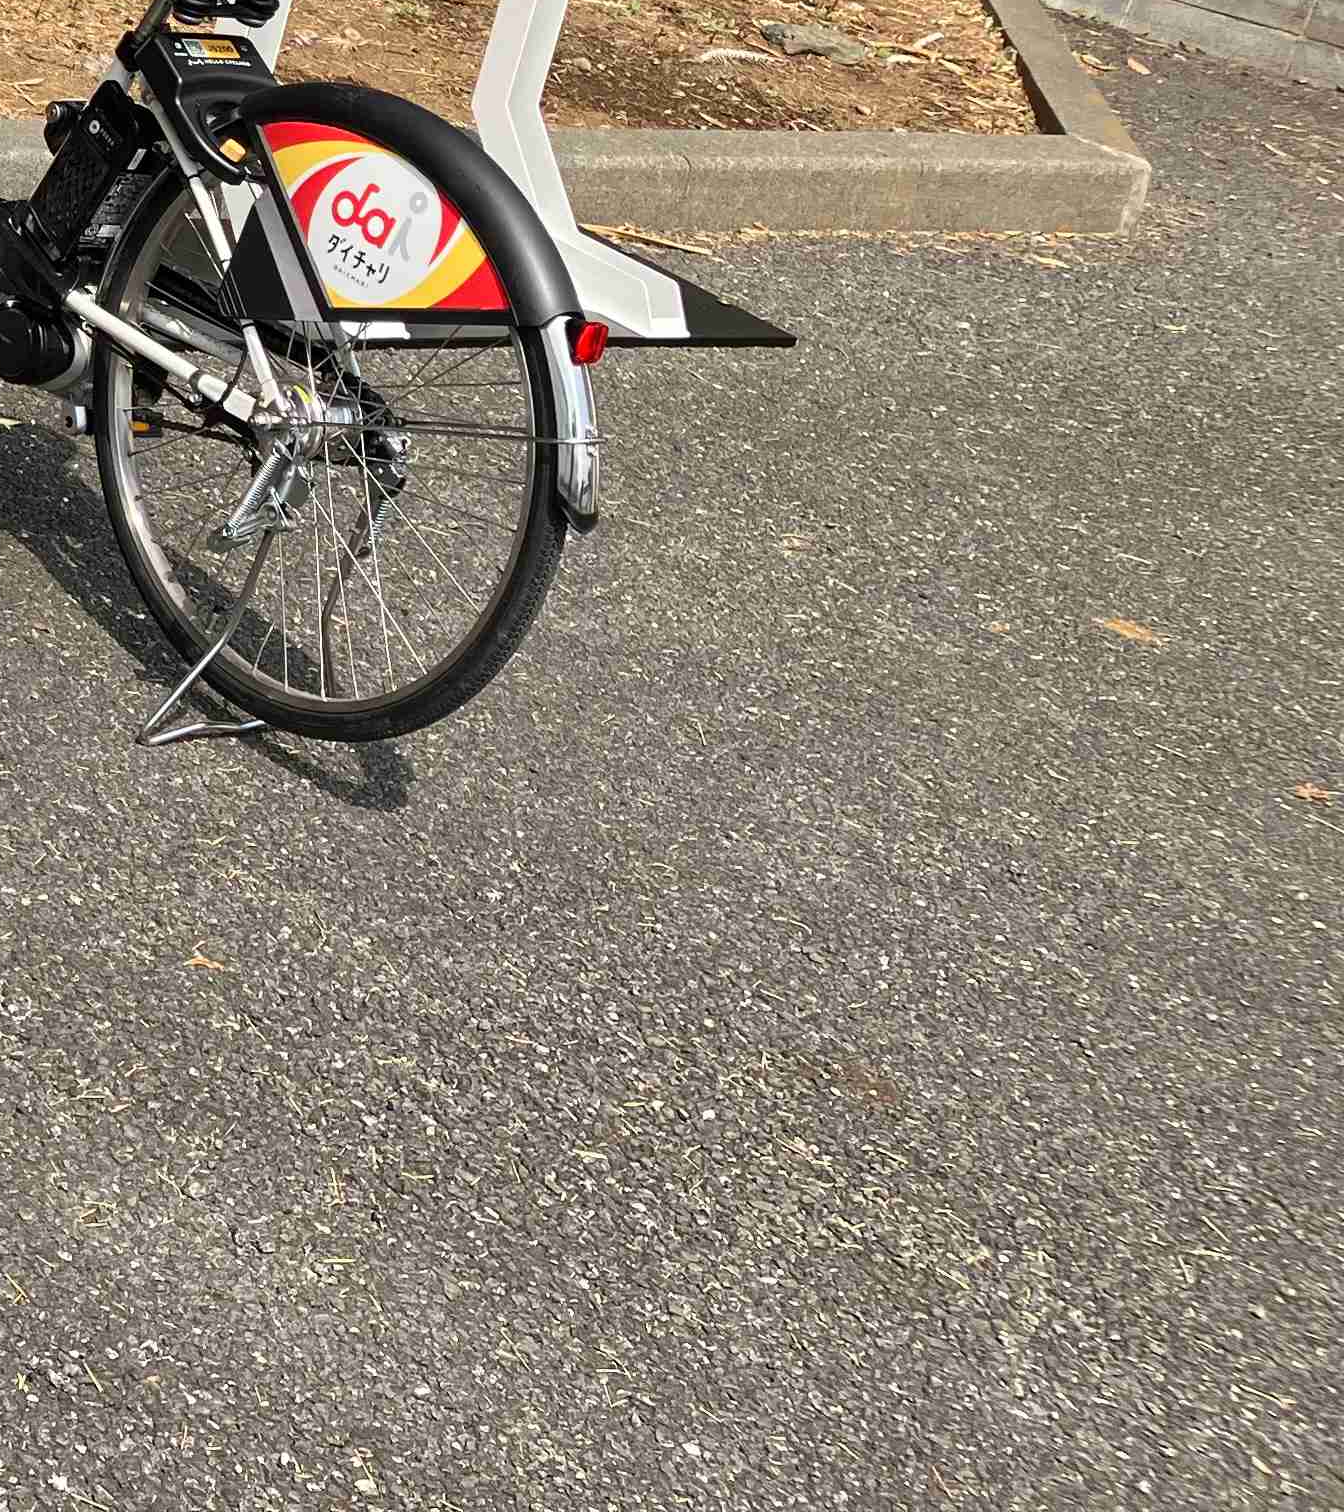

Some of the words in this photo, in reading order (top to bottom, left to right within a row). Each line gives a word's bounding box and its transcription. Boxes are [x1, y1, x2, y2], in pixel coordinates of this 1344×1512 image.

[327, 234, 392, 285] ダイチャリ
